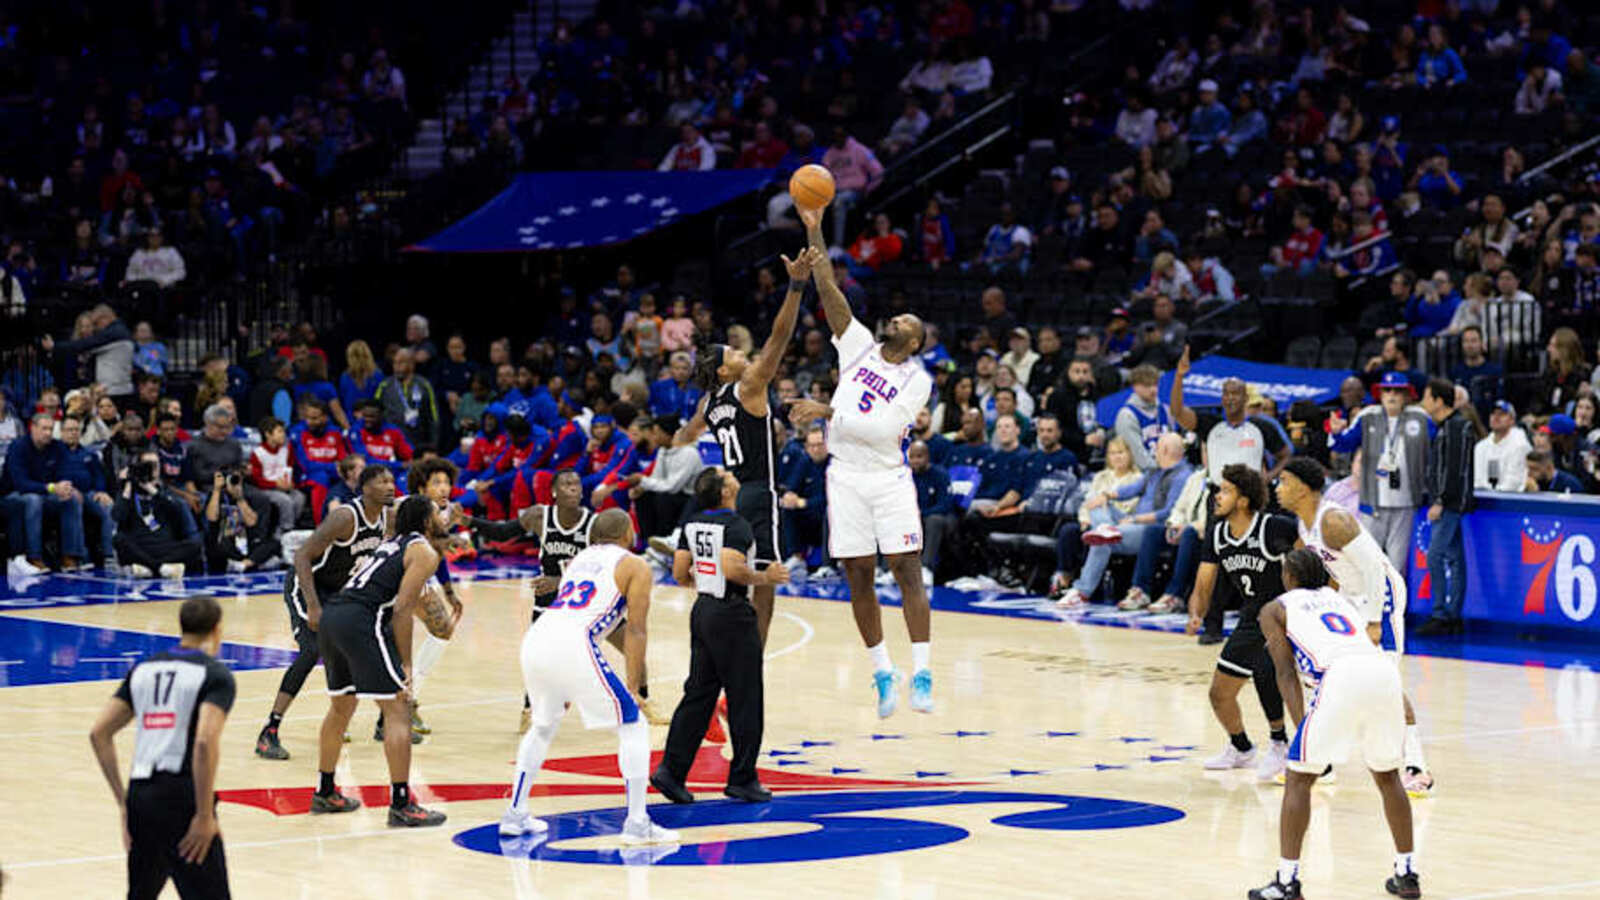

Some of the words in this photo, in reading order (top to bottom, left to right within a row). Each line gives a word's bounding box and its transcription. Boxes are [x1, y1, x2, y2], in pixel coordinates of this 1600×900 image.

[858, 391, 876, 413] 5
[717, 425, 743, 465] 21
[696, 531, 713, 557] 55
[1241, 575, 1255, 596] 2
[1521, 529, 1597, 622] 76
[547, 580, 598, 610] 23
[1319, 612, 1357, 636] 0
[154, 671, 177, 706] 17
